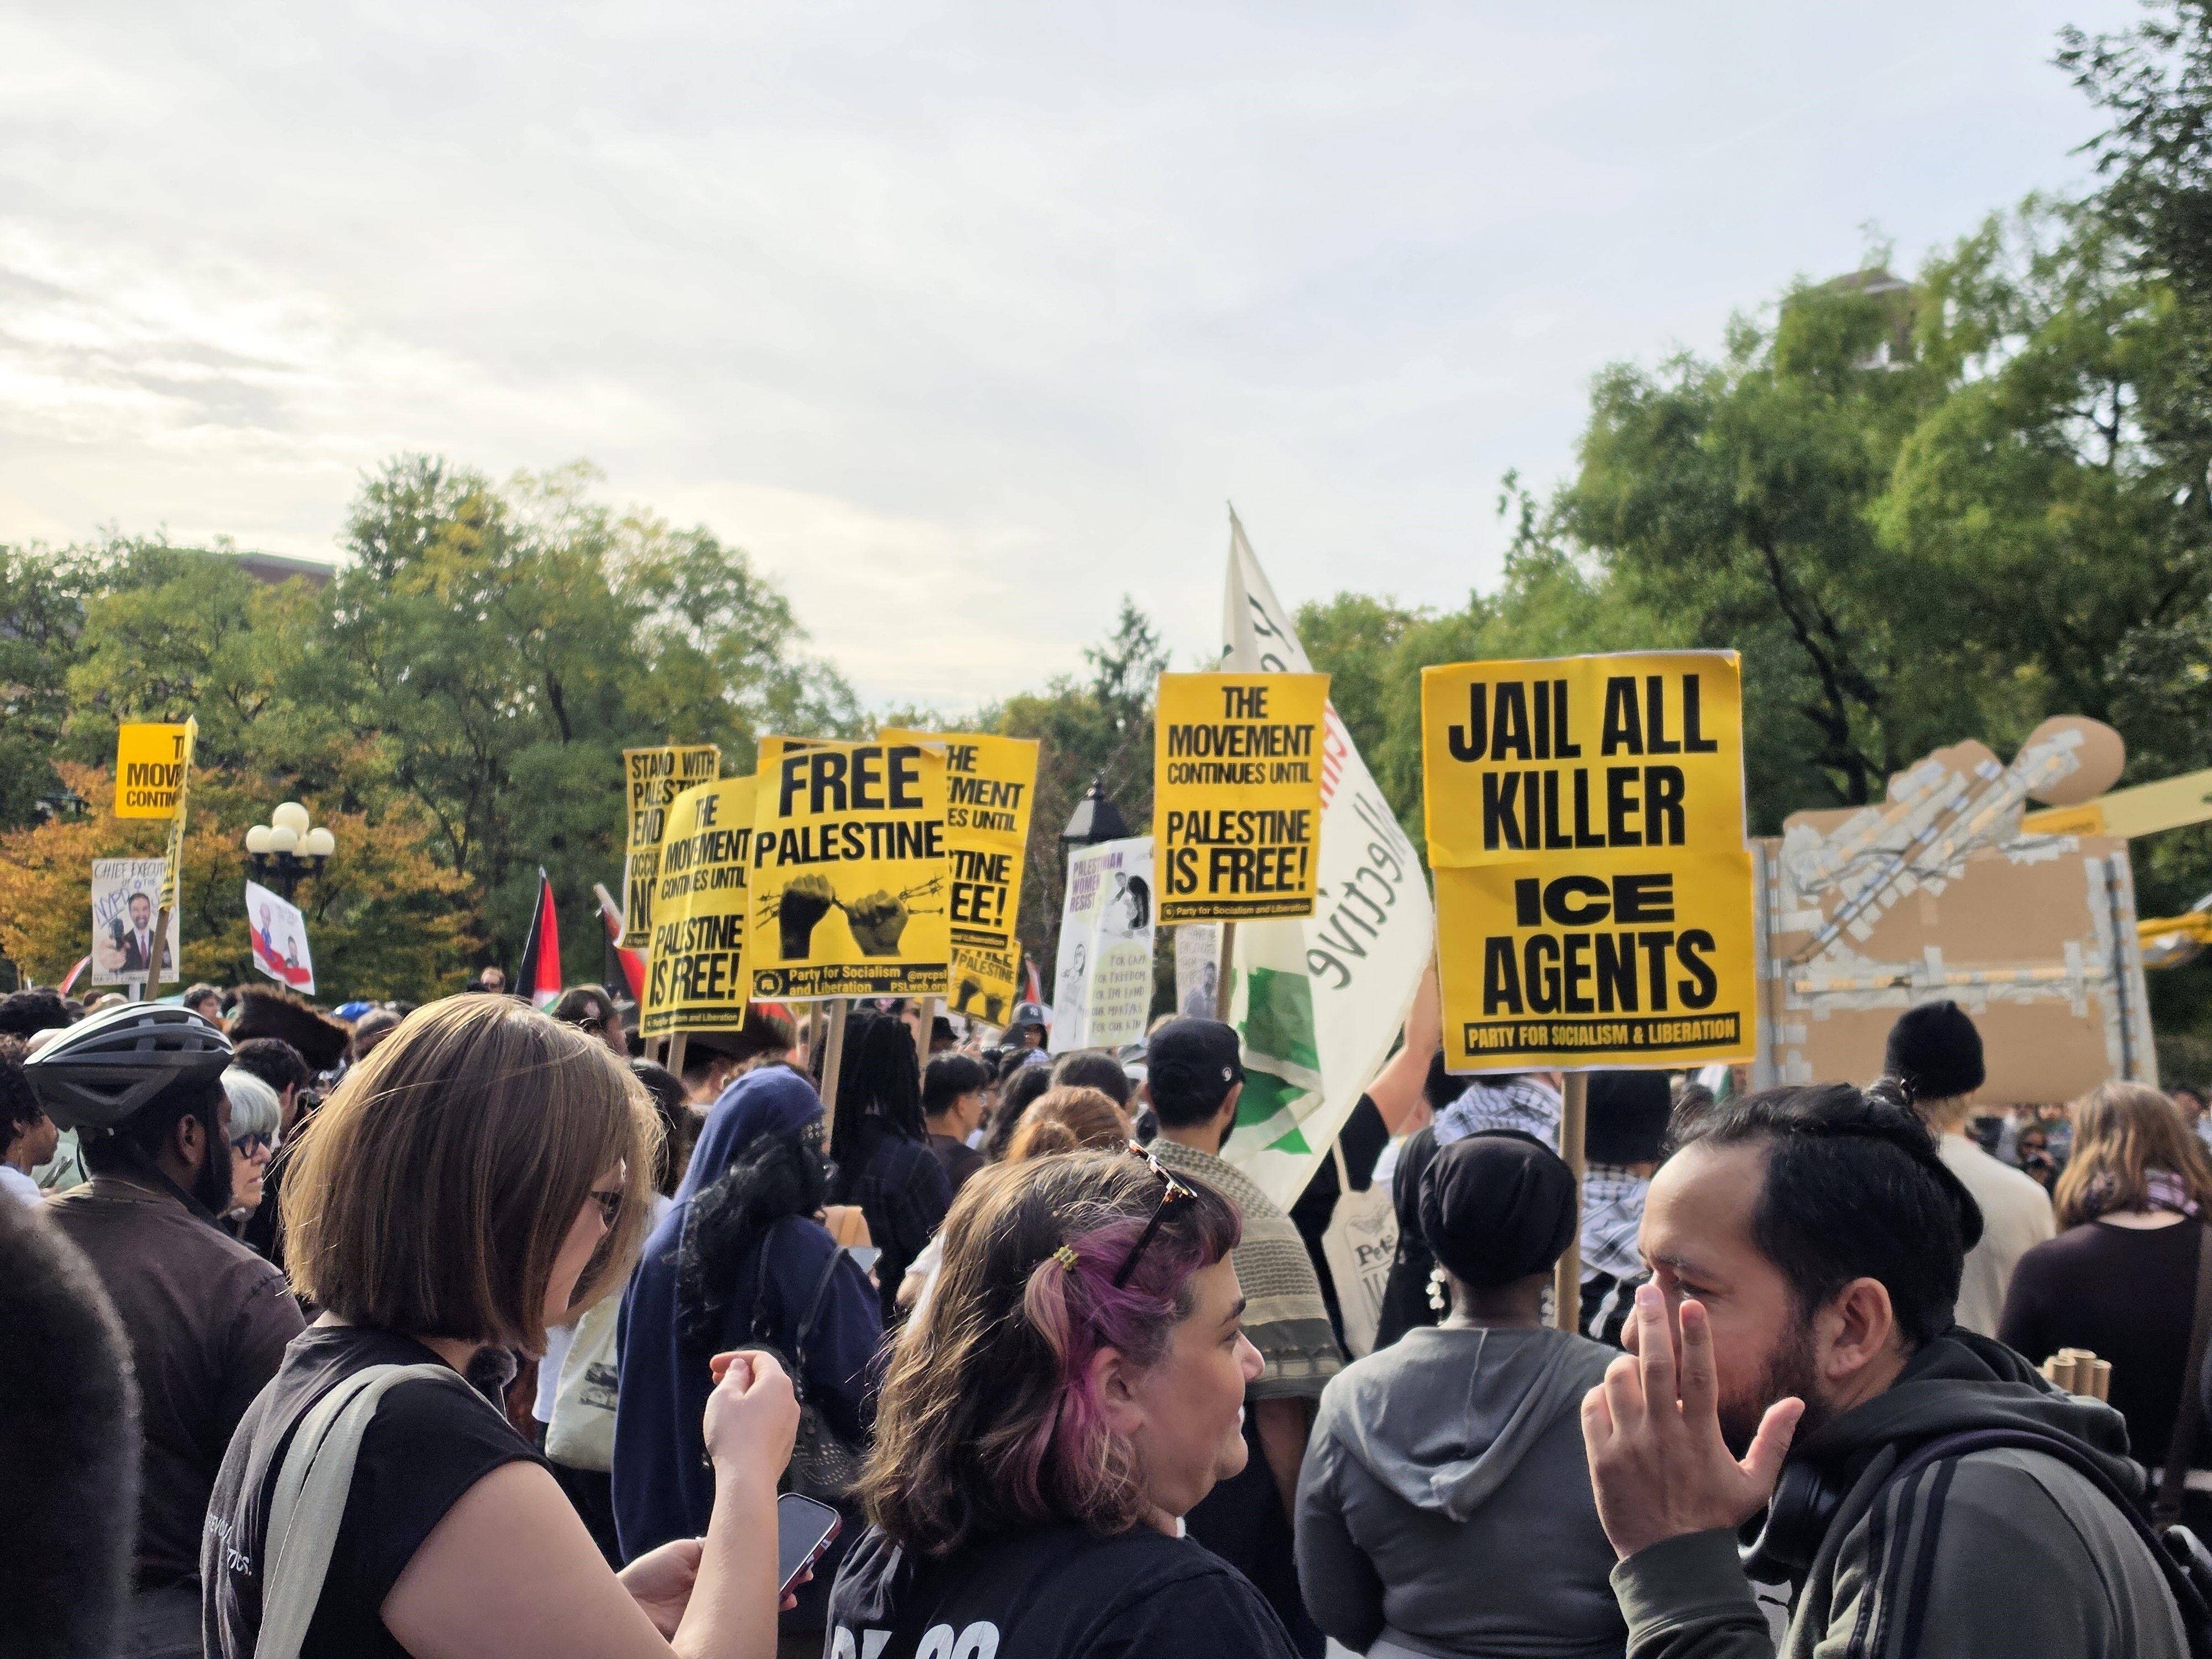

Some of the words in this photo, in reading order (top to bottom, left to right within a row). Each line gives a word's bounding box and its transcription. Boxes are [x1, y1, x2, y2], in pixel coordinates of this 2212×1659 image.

[1221, 686, 1269, 719] THE
[1448, 679, 1581, 762] JAIL
[1601, 674, 1718, 756] ALL
[1168, 724, 1315, 758] MOVEMENT
[631, 751, 675, 779] STAND
[682, 750, 715, 778] WITH
[946, 744, 978, 773] HE
[1167, 762, 1266, 785] CONTINUES
[1270, 761, 1313, 784] UNTIL
[633, 778, 712, 808] PALEST
[779, 745, 924, 818] FREE
[946, 775, 1025, 810] MENT
[972, 810, 1018, 832] UNTIL
[1482, 765, 1686, 851] KILLER
[633, 807, 665, 847] END
[1167, 810, 1311, 846] PALESTINE
[665, 828, 753, 875] MOVEMENT
[754, 820, 946, 869] PALESTINE
[95, 862, 126, 879] CHIEF
[131, 861, 166, 878] EXECUT
[661, 869, 708, 900] CONTINES
[711, 866, 747, 890] UNTIL
[949, 849, 1013, 884] TINE
[1166, 847, 1199, 895] IS
[1208, 846, 1308, 894] FREE!
[950, 881, 1007, 928] EE!
[1070, 891, 1096, 912] RESIST
[1176, 907, 1197, 916] Party
[1213, 905, 1254, 915] Socialism
[1255, 905, 1270, 913] and
[1272, 903, 1310, 912] Liberation
[1515, 873, 1675, 927] ICE
[789, 969, 820, 983] Party
[823, 966, 839, 978] for
[842, 966, 901, 978] Socialism
[958, 952, 1014, 984] PALESTINE
[1110, 955, 1125, 966] FOR
[1128, 954, 1146, 966] GAZA
[1483, 929, 1718, 1016] AGENTS
[649, 959, 668, 1008] IS
[789, 983, 811, 995] and
[815, 980, 872, 994] Liberation
[1110, 971, 1146, 983] FREEDOM
[1092, 1021, 1106, 1033] FOR
[1468, 1026, 1515, 1048] PARTY
[1520, 1025, 1548, 1047] FOR
[1552, 1024, 1628, 1047] SOCIALISM
[1633, 1026, 1643, 1044] &
[1649, 1018, 1736, 1043] LIBERATION
